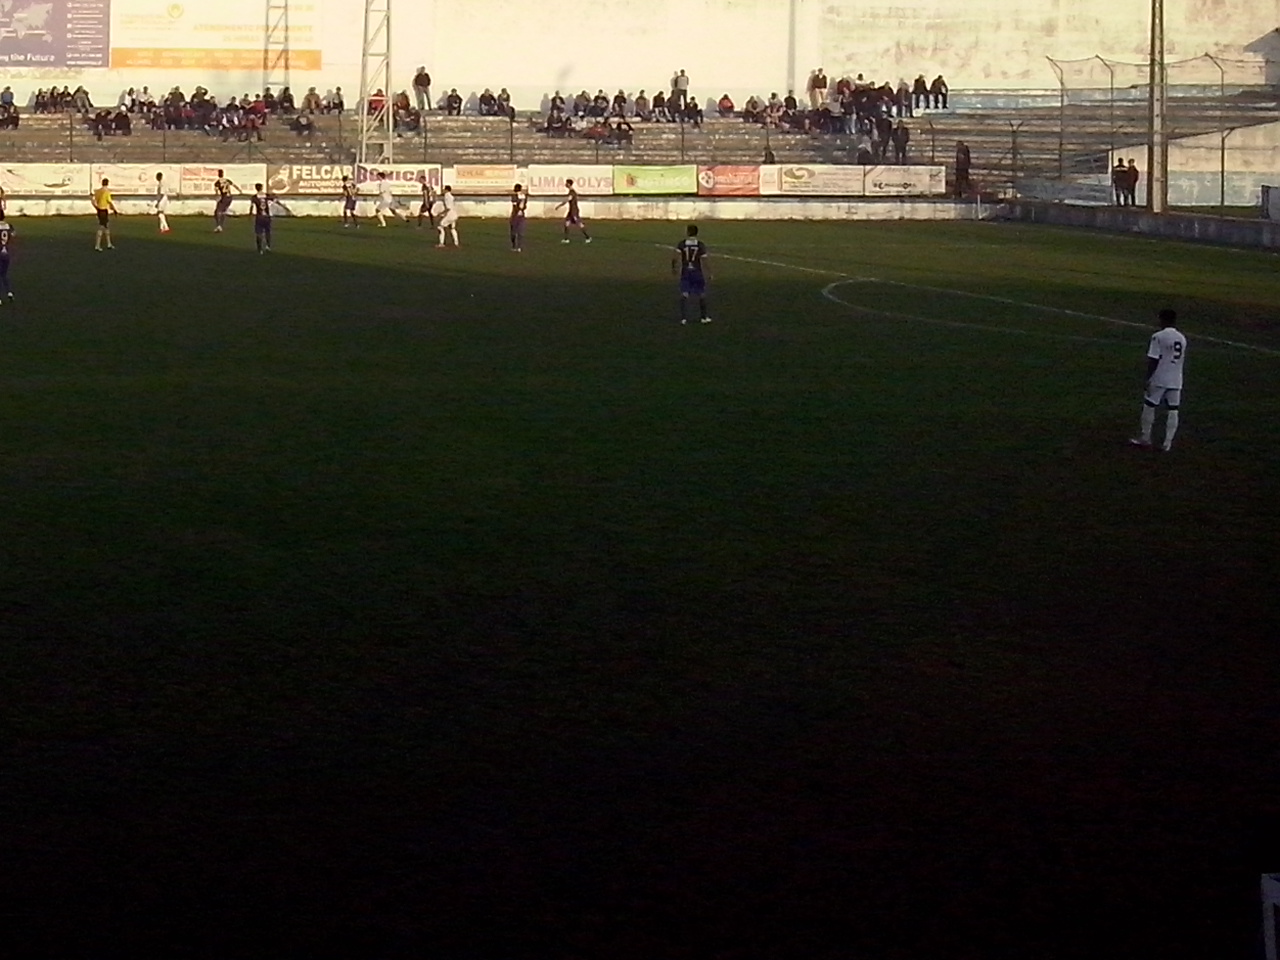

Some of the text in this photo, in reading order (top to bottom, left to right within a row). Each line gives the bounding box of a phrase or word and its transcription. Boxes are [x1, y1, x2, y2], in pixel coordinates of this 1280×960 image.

[10, 53, 25, 62] the
[26, 53, 56, 63] Future
[292, 165, 354, 180] FELCAR
[684, 246, 699, 262] 17
[1173, 341, 1182, 360] 9
